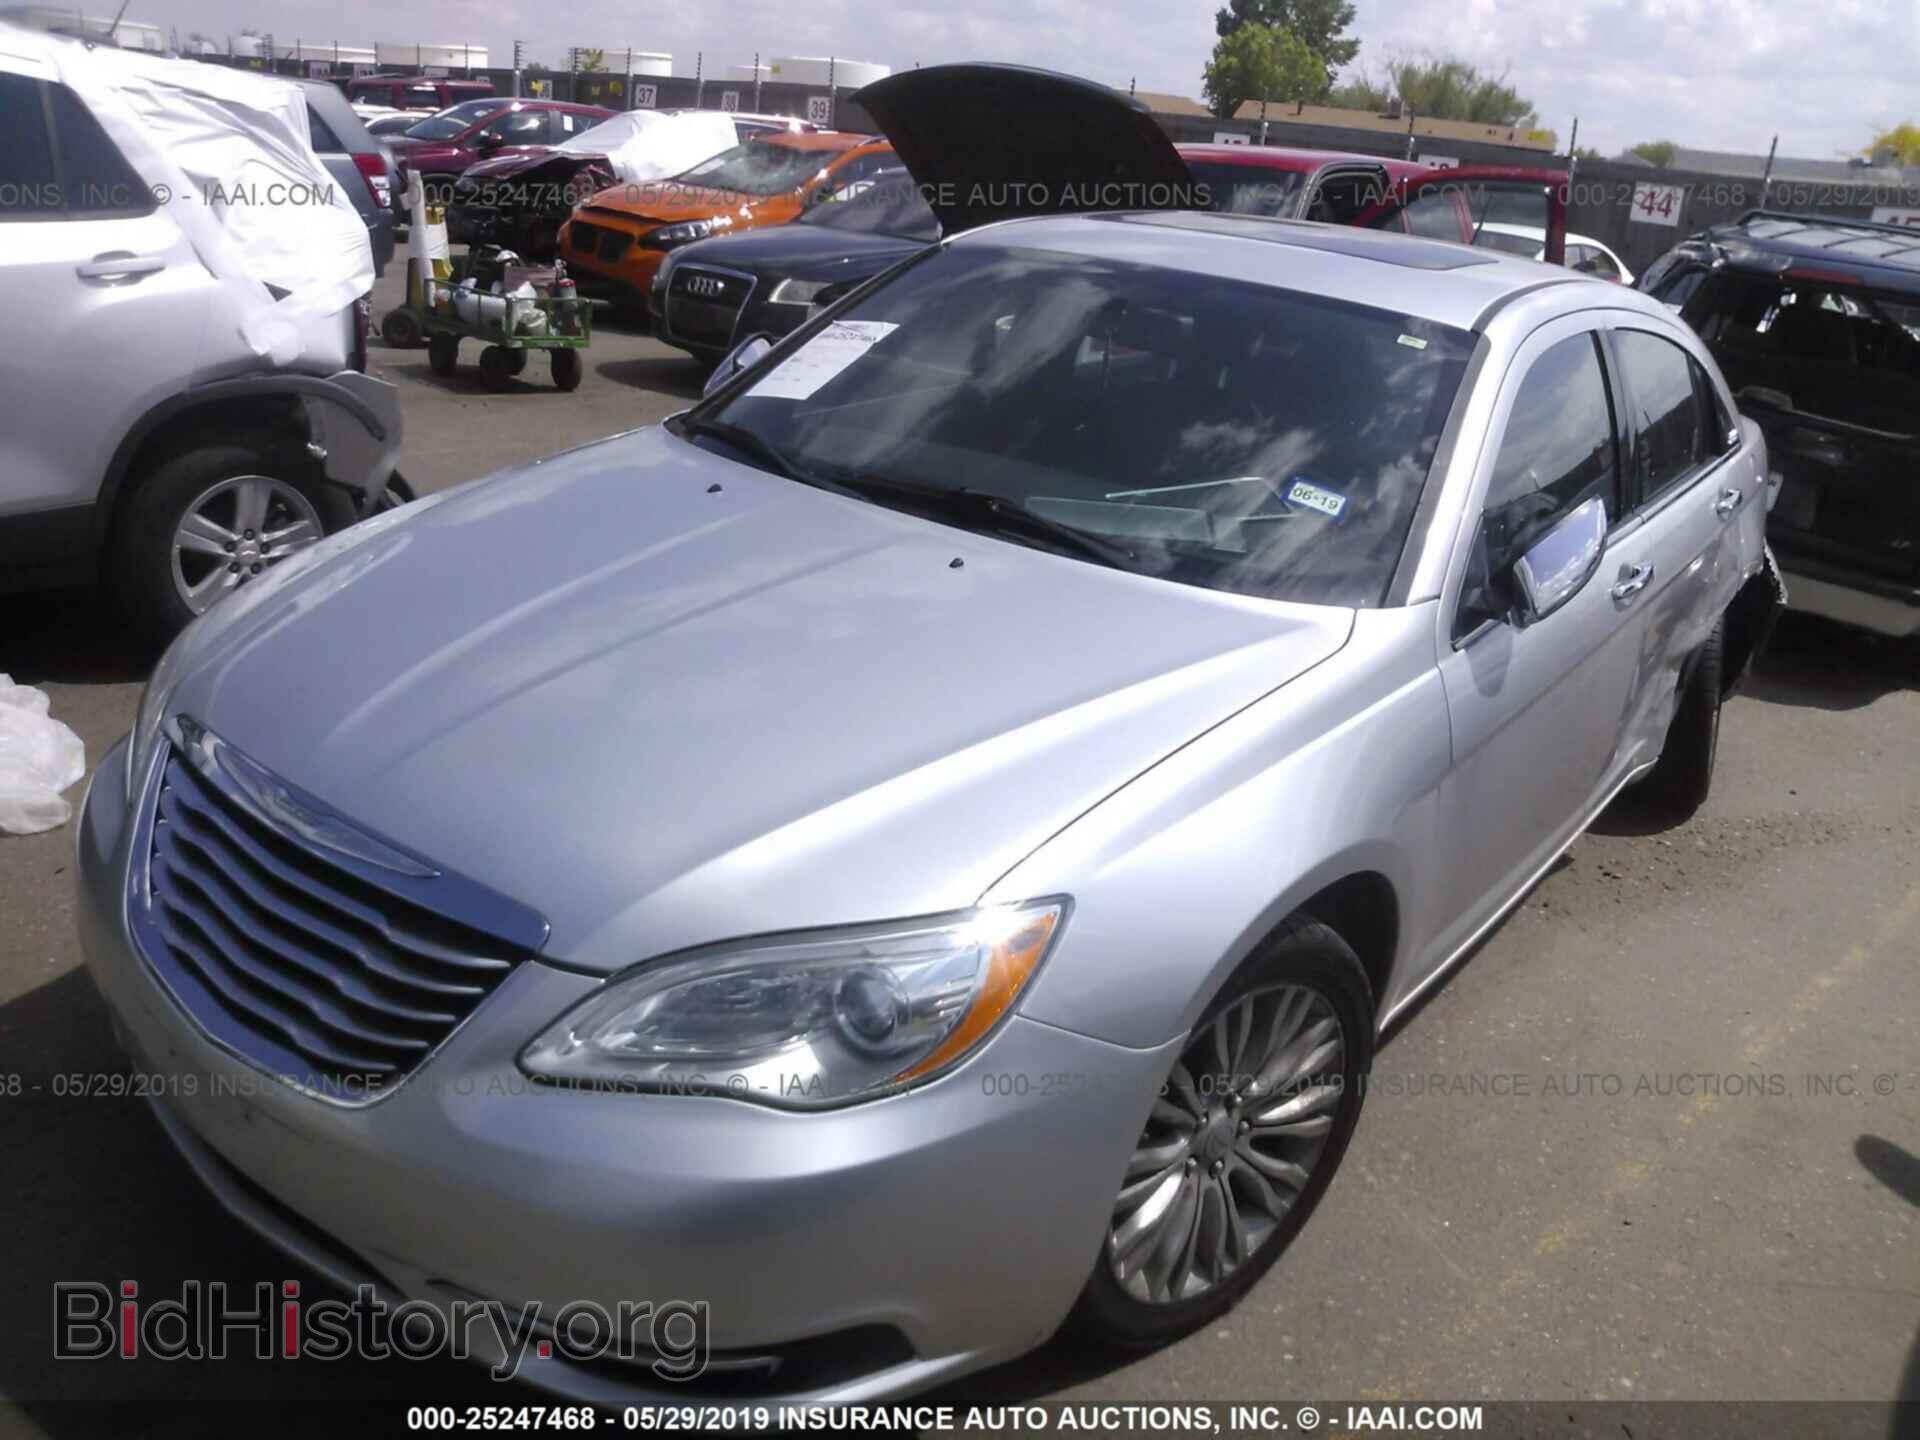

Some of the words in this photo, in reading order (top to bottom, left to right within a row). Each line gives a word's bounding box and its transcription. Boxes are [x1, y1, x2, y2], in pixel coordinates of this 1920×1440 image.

[639, 86, 653, 104] 37
[811, 100, 827, 119] 39
[1639, 191, 1673, 218] 44
[1292, 487, 1339, 510] 06-19
